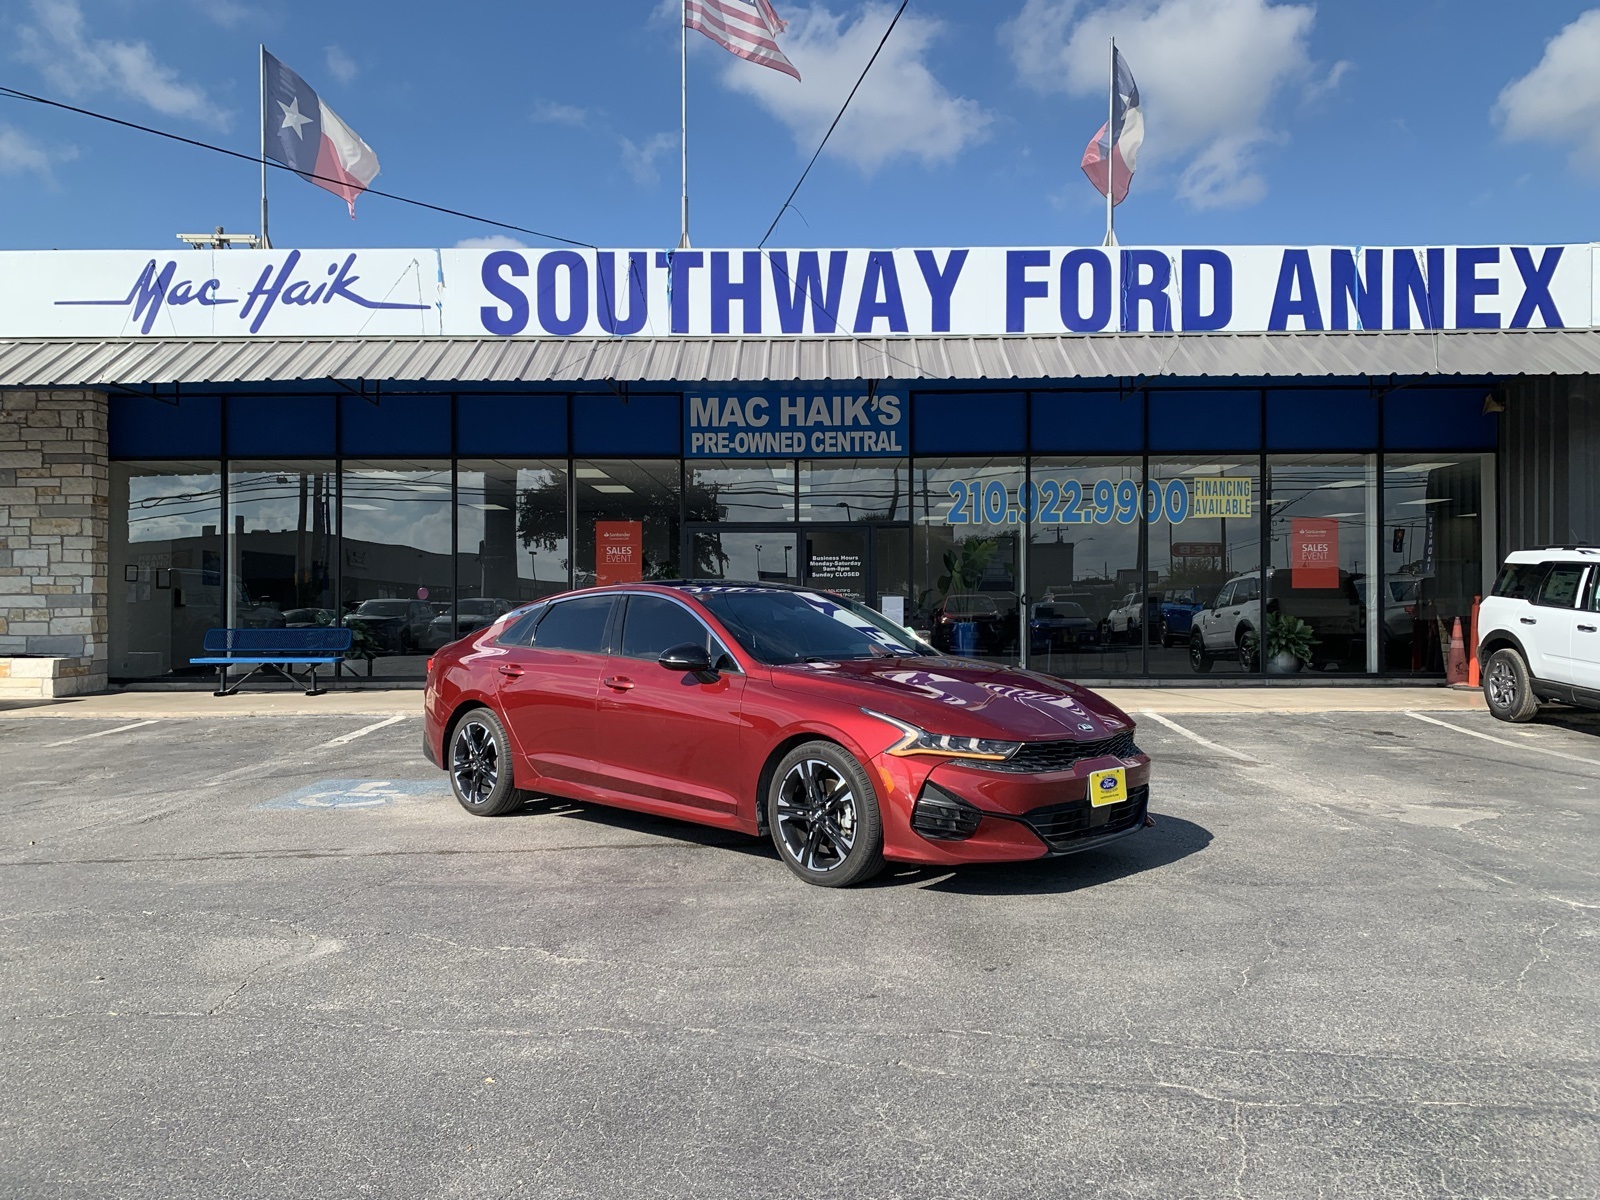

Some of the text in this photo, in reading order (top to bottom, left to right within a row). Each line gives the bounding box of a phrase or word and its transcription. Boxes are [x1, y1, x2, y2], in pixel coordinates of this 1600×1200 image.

[54, 249, 431, 335] Mac Haik
[480, 245, 1565, 336] SOUTHWAY FORD ANNEX
[690, 395, 902, 428] MAC HAIK'S
[691, 430, 902, 454] PRE-OWNED CENTRAL
[1195, 480, 1250, 497] FINANCING
[947, 478, 1190, 525] 210.922.9900
[1195, 498, 1251, 515] AVAILABLE
[606, 546, 632, 555] SALES
[1302, 543, 1328, 552] SALES
[1302, 552, 1328, 560] EVENT
[606, 555, 632, 563] EVENT
